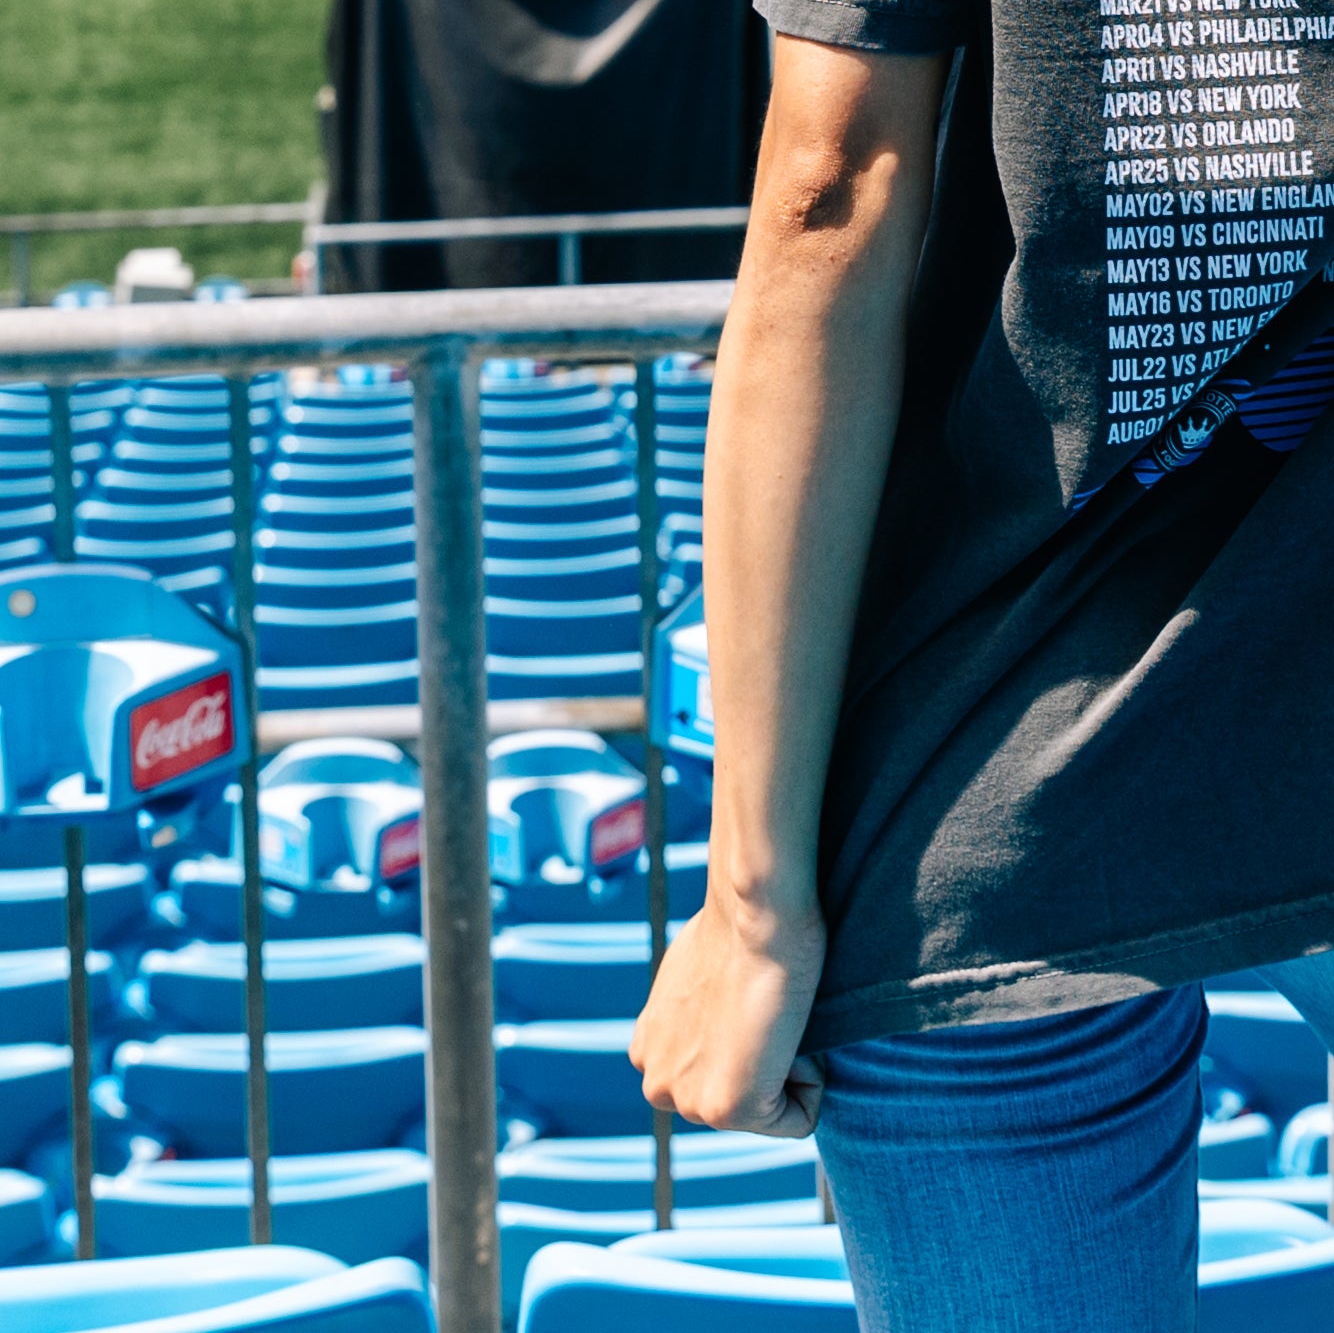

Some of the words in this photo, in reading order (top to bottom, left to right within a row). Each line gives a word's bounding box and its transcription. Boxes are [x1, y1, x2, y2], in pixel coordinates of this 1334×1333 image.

[1101, 23, 1164, 50] APR04
[1168, 21, 1194, 46] VS
[1101, 57, 1154, 83] APR11
[1160, 55, 1186, 80] VS
[1191, 49, 1299, 78] NASHVILLE
[1103, 91, 1162, 118] APR18
[1167, 89, 1192, 114] VS
[1198, 87, 1242, 112] NEW
[1245, 82, 1301, 110] YORK
[1104, 127, 1166, 152] APR22
[1173, 124, 1197, 148] VS
[1203, 118, 1295, 145] ORLANDO
[1105, 160, 1168, 185] APR25
[1174, 157, 1199, 181] VS
[1205, 150, 1313, 179] NASHVILLE
[1106, 192, 1174, 218] MAY02
[1180, 190, 1206, 214] VS
[1212, 187, 1255, 212] NEW
[1107, 225, 1174, 250] MAY09
[1181, 223, 1206, 247] VS
[1212, 216, 1324, 245] CINCINNATI
[1107, 258, 1170, 283] MAY13
[1176, 256, 1202, 280] VS
[1208, 253, 1251, 278] NEW
[1257, 249, 1307, 276] YORK
[1108, 291, 1171, 316] MAY16
[1177, 289, 1202, 313] VS
[1208, 280, 1294, 311] TORONTO
[1109, 324, 1174, 350] MAY23
[1181, 321, 1206, 346] VS
[1212, 314, 1257, 342] NEW
[1108, 357, 1165, 383] JUL22
[1172, 355, 1196, 378] VS
[1108, 390, 1166, 415] JUL25
[1172, 383, 1194, 409] VS
[1108, 417, 1163, 445] AUG01
